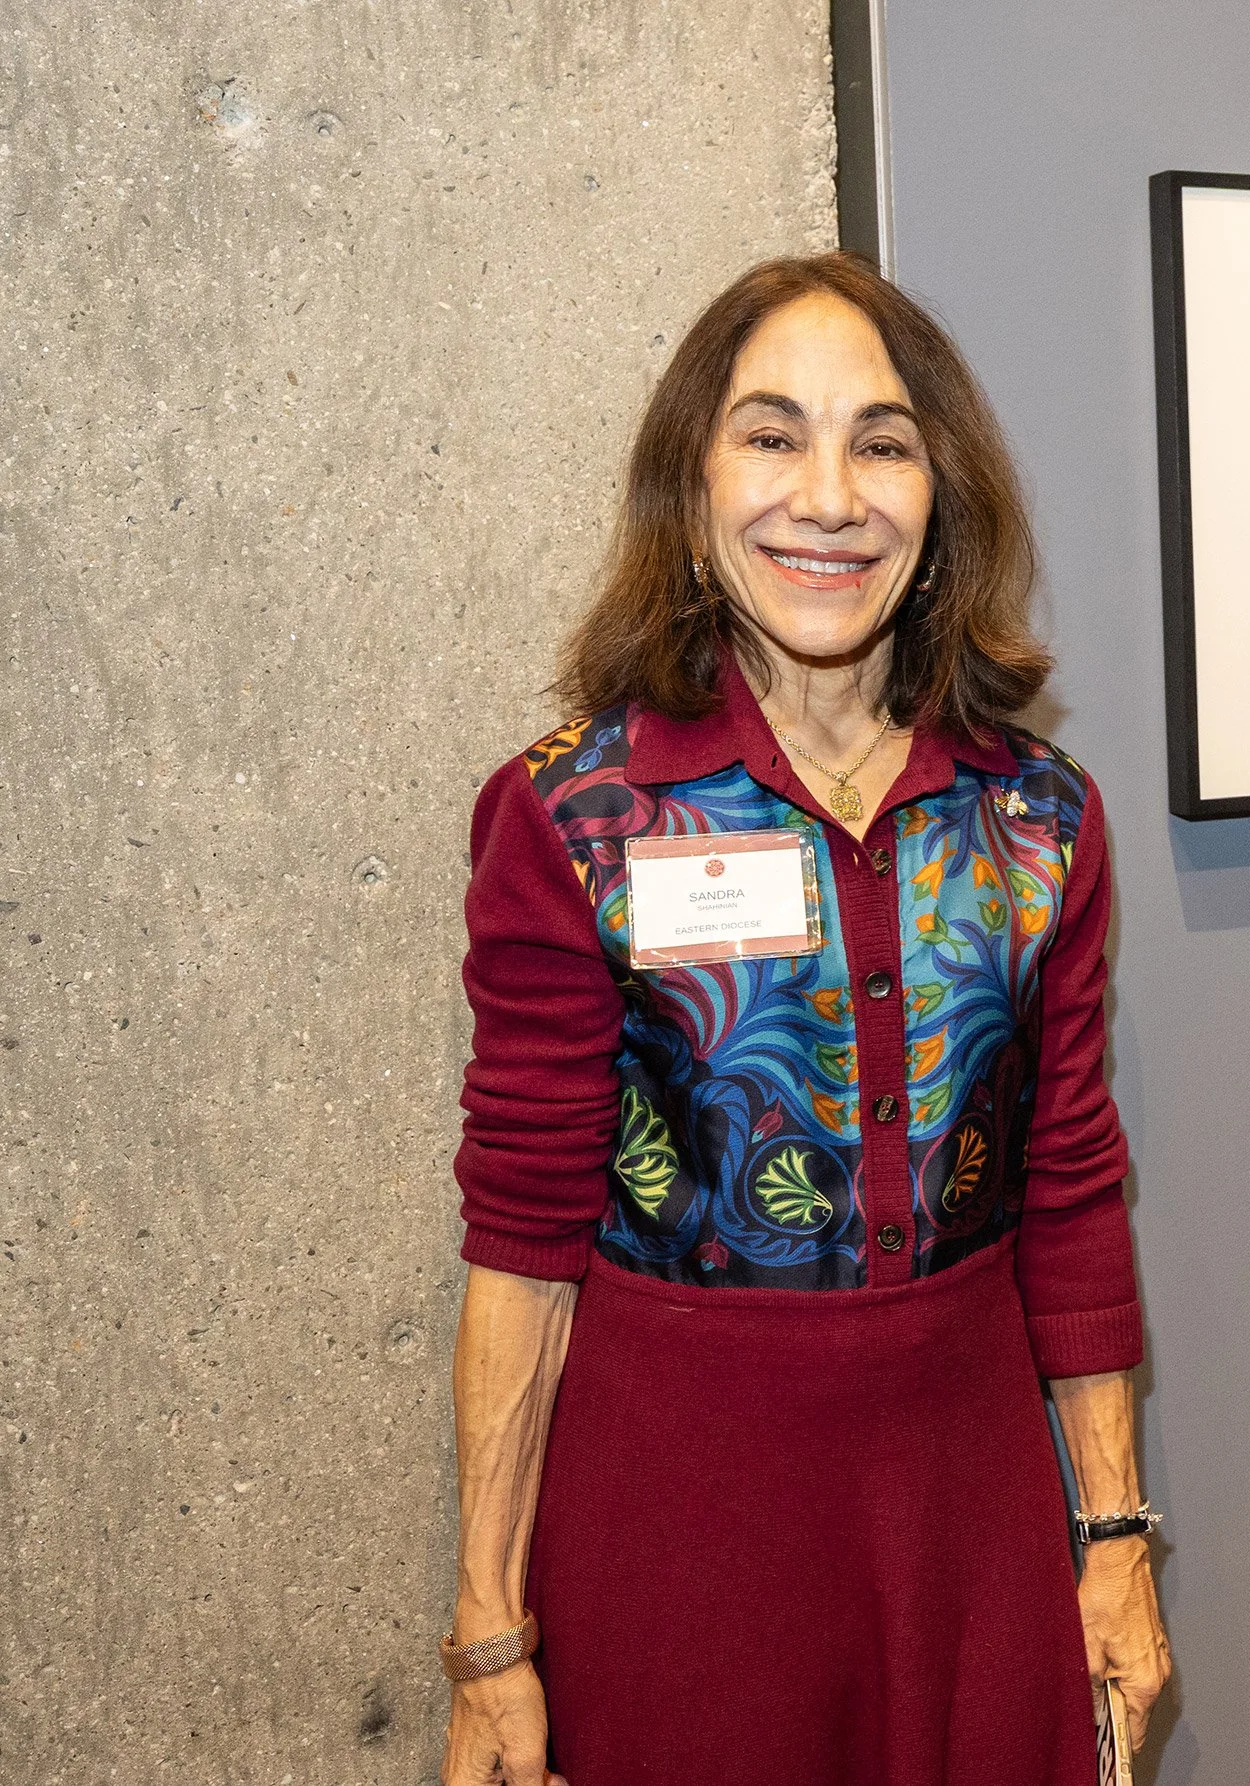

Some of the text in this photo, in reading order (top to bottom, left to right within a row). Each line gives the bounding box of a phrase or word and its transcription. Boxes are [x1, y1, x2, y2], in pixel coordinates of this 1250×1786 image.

[689, 888, 745, 902] SANDRA
[675, 919, 762, 935] EASTERN DIOCESE
